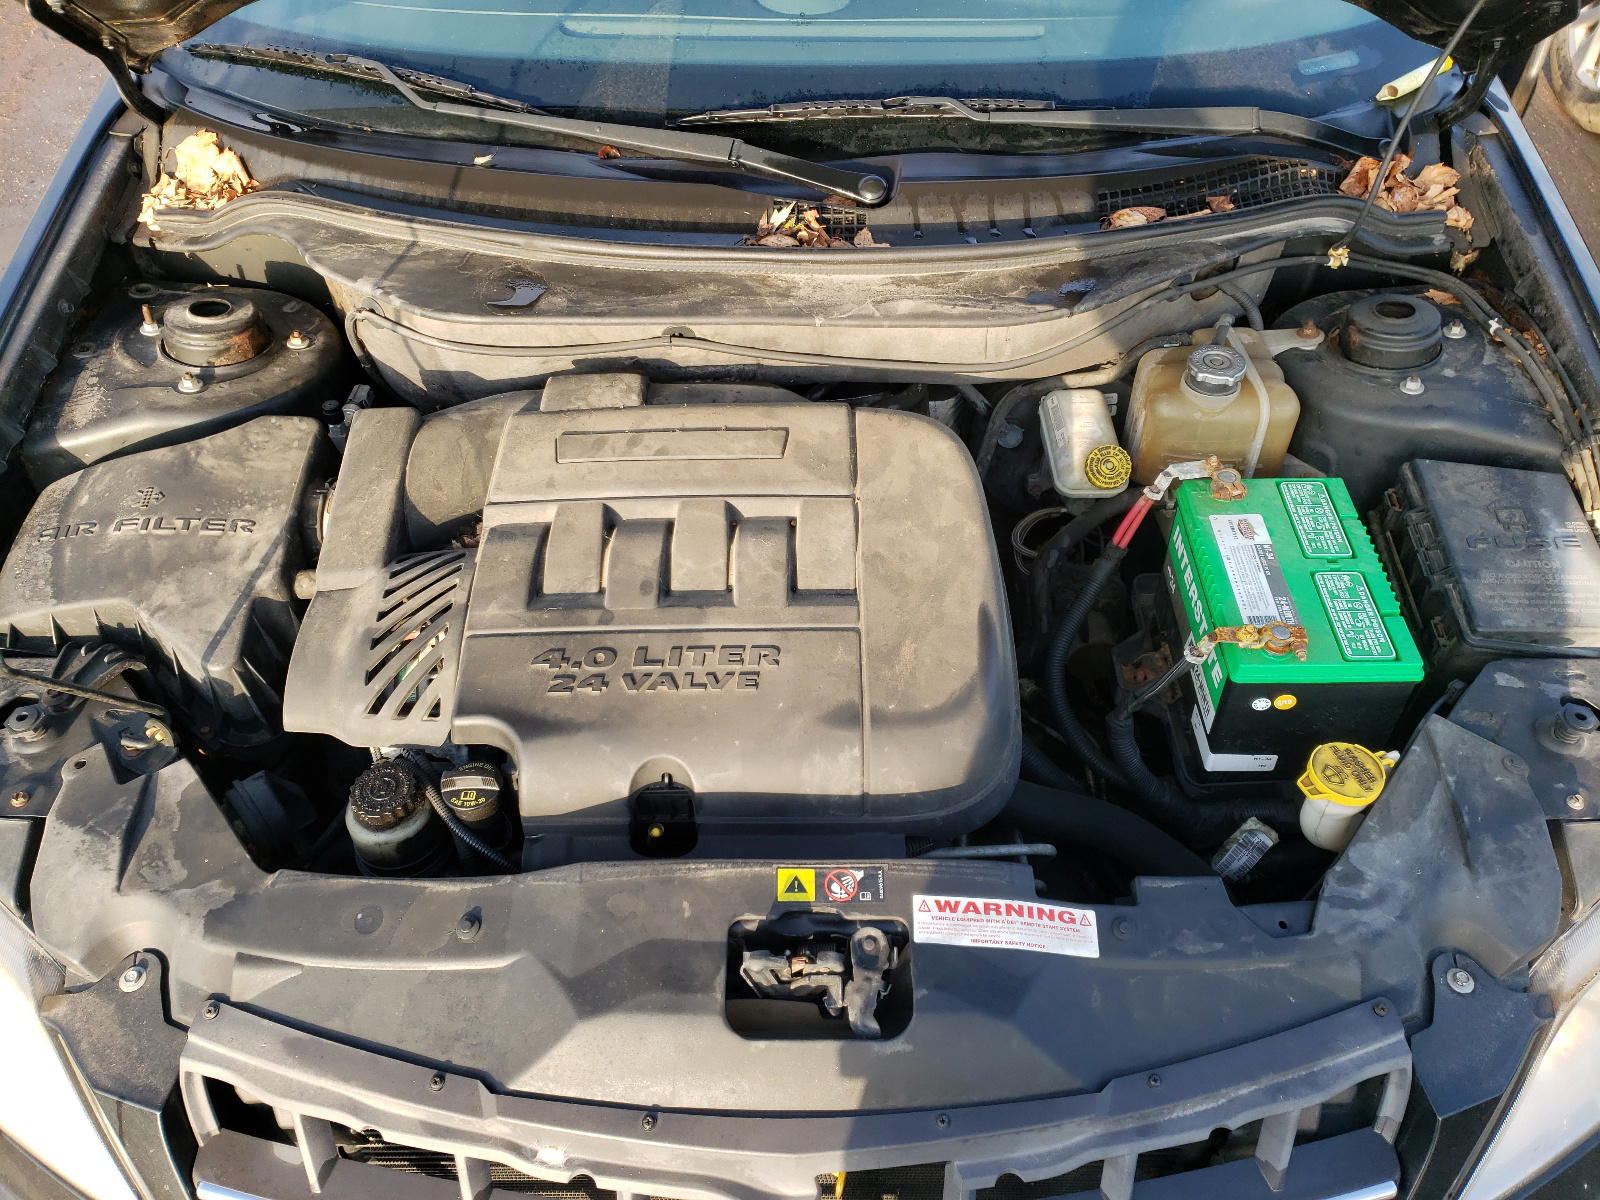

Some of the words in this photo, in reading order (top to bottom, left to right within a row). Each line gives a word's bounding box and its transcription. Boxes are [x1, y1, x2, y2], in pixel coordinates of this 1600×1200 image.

[38, 521, 98, 542] AIR
[112, 517, 257, 534] FILTER
[1465, 534, 1583, 551] FUSE
[1504, 560, 1562, 569] CAUTION
[1173, 526, 1223, 690] INTERSTTE
[530, 646, 618, 669] 4.0
[632, 645, 782, 668] LITER
[546, 673, 610, 693] 24
[621, 671, 760, 692] VALVE
[450, 797, 463, 806] SAE
[934, 899, 1077, 925] WARNING
[1021, 920, 1042, 928] REMOTE
[1042, 922, 1058, 930] START
[1059, 925, 1081, 933] SYSTEM
[970, 938, 1003, 946] IMPORTANT
